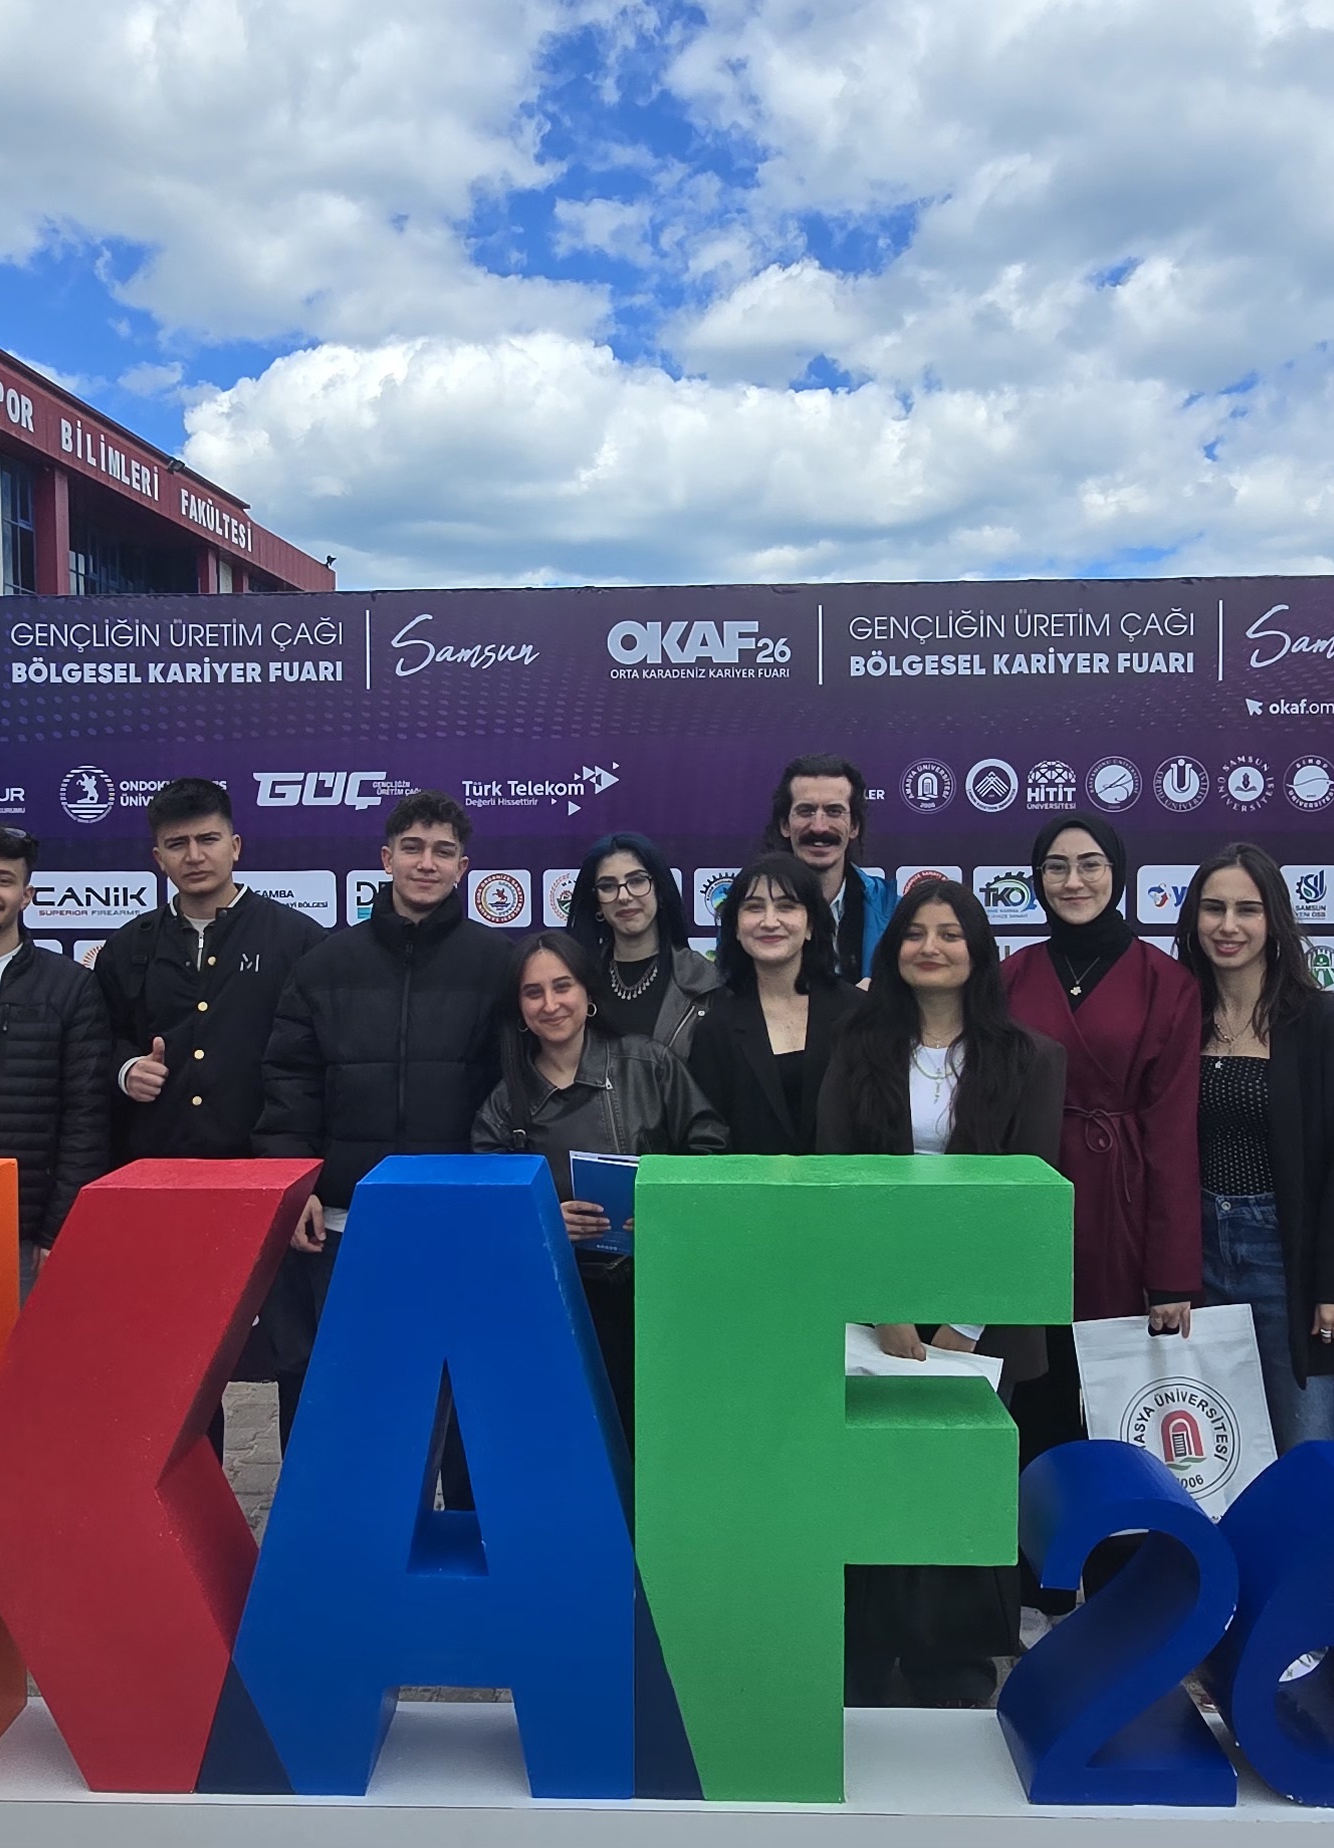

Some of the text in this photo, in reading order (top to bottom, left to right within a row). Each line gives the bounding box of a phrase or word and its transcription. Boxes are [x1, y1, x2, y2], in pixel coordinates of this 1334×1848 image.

[60, 417, 161, 502] BİLİMLERİ
[180, 488, 253, 553] FAKÜLTESİ
[11, 616, 343, 653] GENÇLİĞİN ÜRETİM ÇAĞI
[849, 607, 1194, 645] GENÇLİĞİN ÜRETİM ÇAĞI
[390, 613, 541, 677] Samsun
[12, 655, 343, 684] BÖLGESEL KARİYER FUARI
[610, 666, 790, 680] ORTA KARADENİZ KARİYER FUARI
[850, 646, 1194, 677] BÖLGESEL KARİYER FUARI
[1222, 755, 1270, 772] SAMSUN
[462, 780, 585, 796] Türk Telekom
[1027, 784, 1076, 802] HİTİT
[465, 797, 496, 807] Değerli
[38, 909, 88, 917] SUPERIOR
[1154, 1388, 1228, 1462] ÜNİVERSİTESİ
[1175, 1474, 1204, 1488] 006
